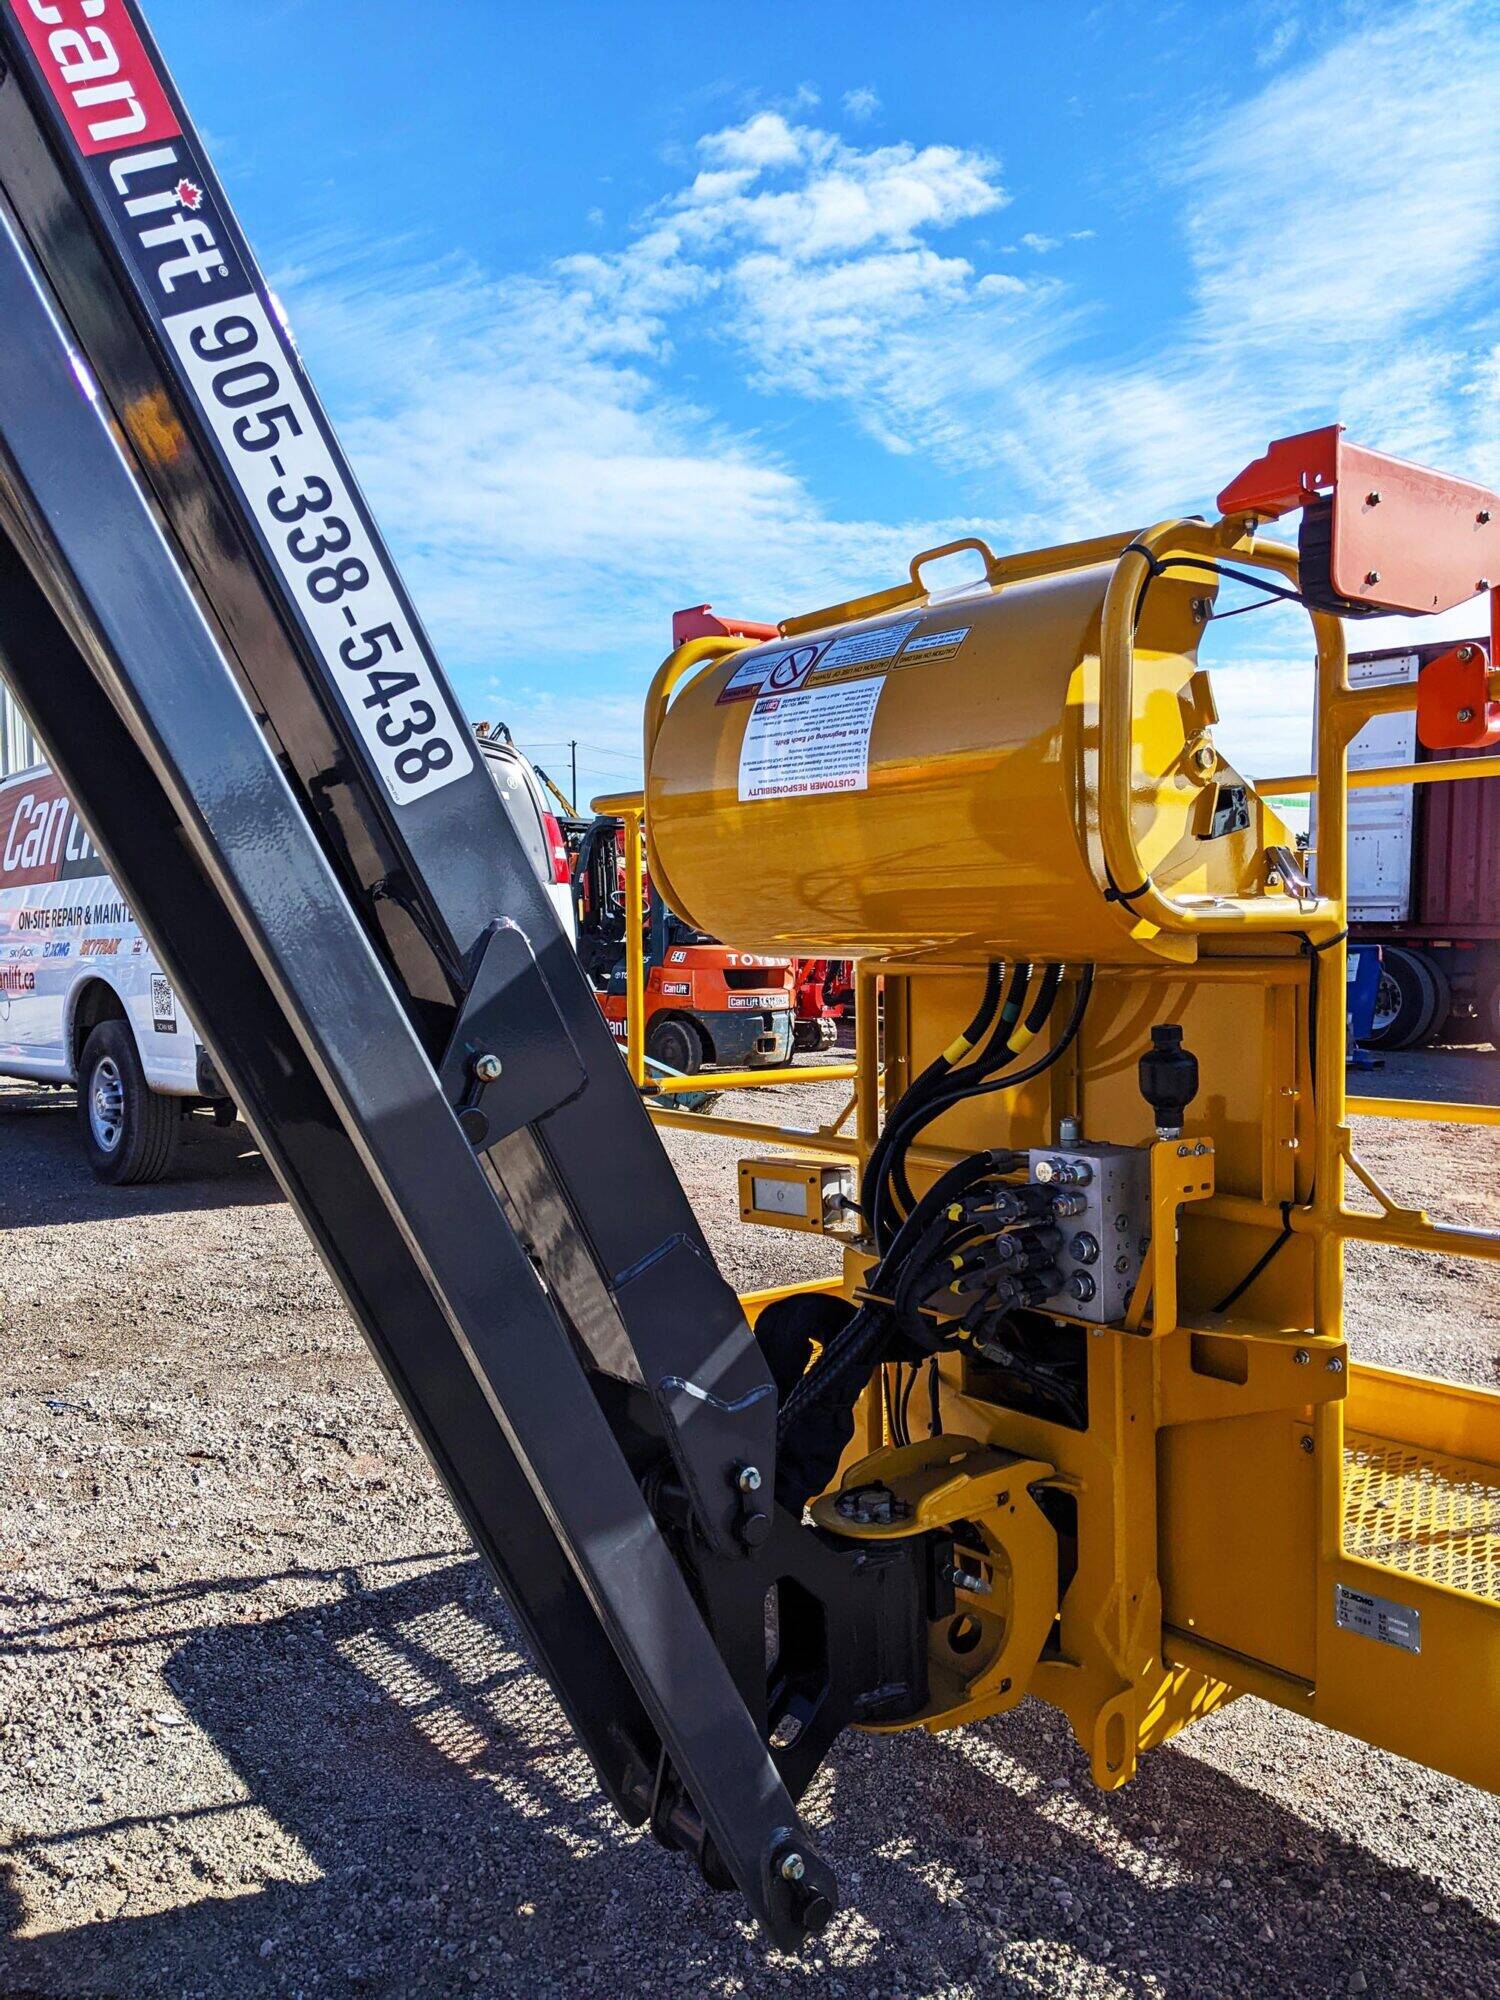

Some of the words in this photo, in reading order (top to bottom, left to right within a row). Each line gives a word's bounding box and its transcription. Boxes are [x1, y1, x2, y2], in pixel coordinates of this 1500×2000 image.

[189, 315, 454, 785] 905-338-5438
[863, 661, 889, 670] CAUTION
[815, 730, 846, 739] Beginning
[747, 783, 807, 796] RESPONSIBILITY
[809, 778, 855, 790] CUSTOMER
[19, 910, 49, 930] ON-SITE
[52, 907, 82, 927] REPAIR
[84, 910, 92, 924] &
[664, 984, 687, 993] CanLift
[730, 997, 759, 1007] CanLift
